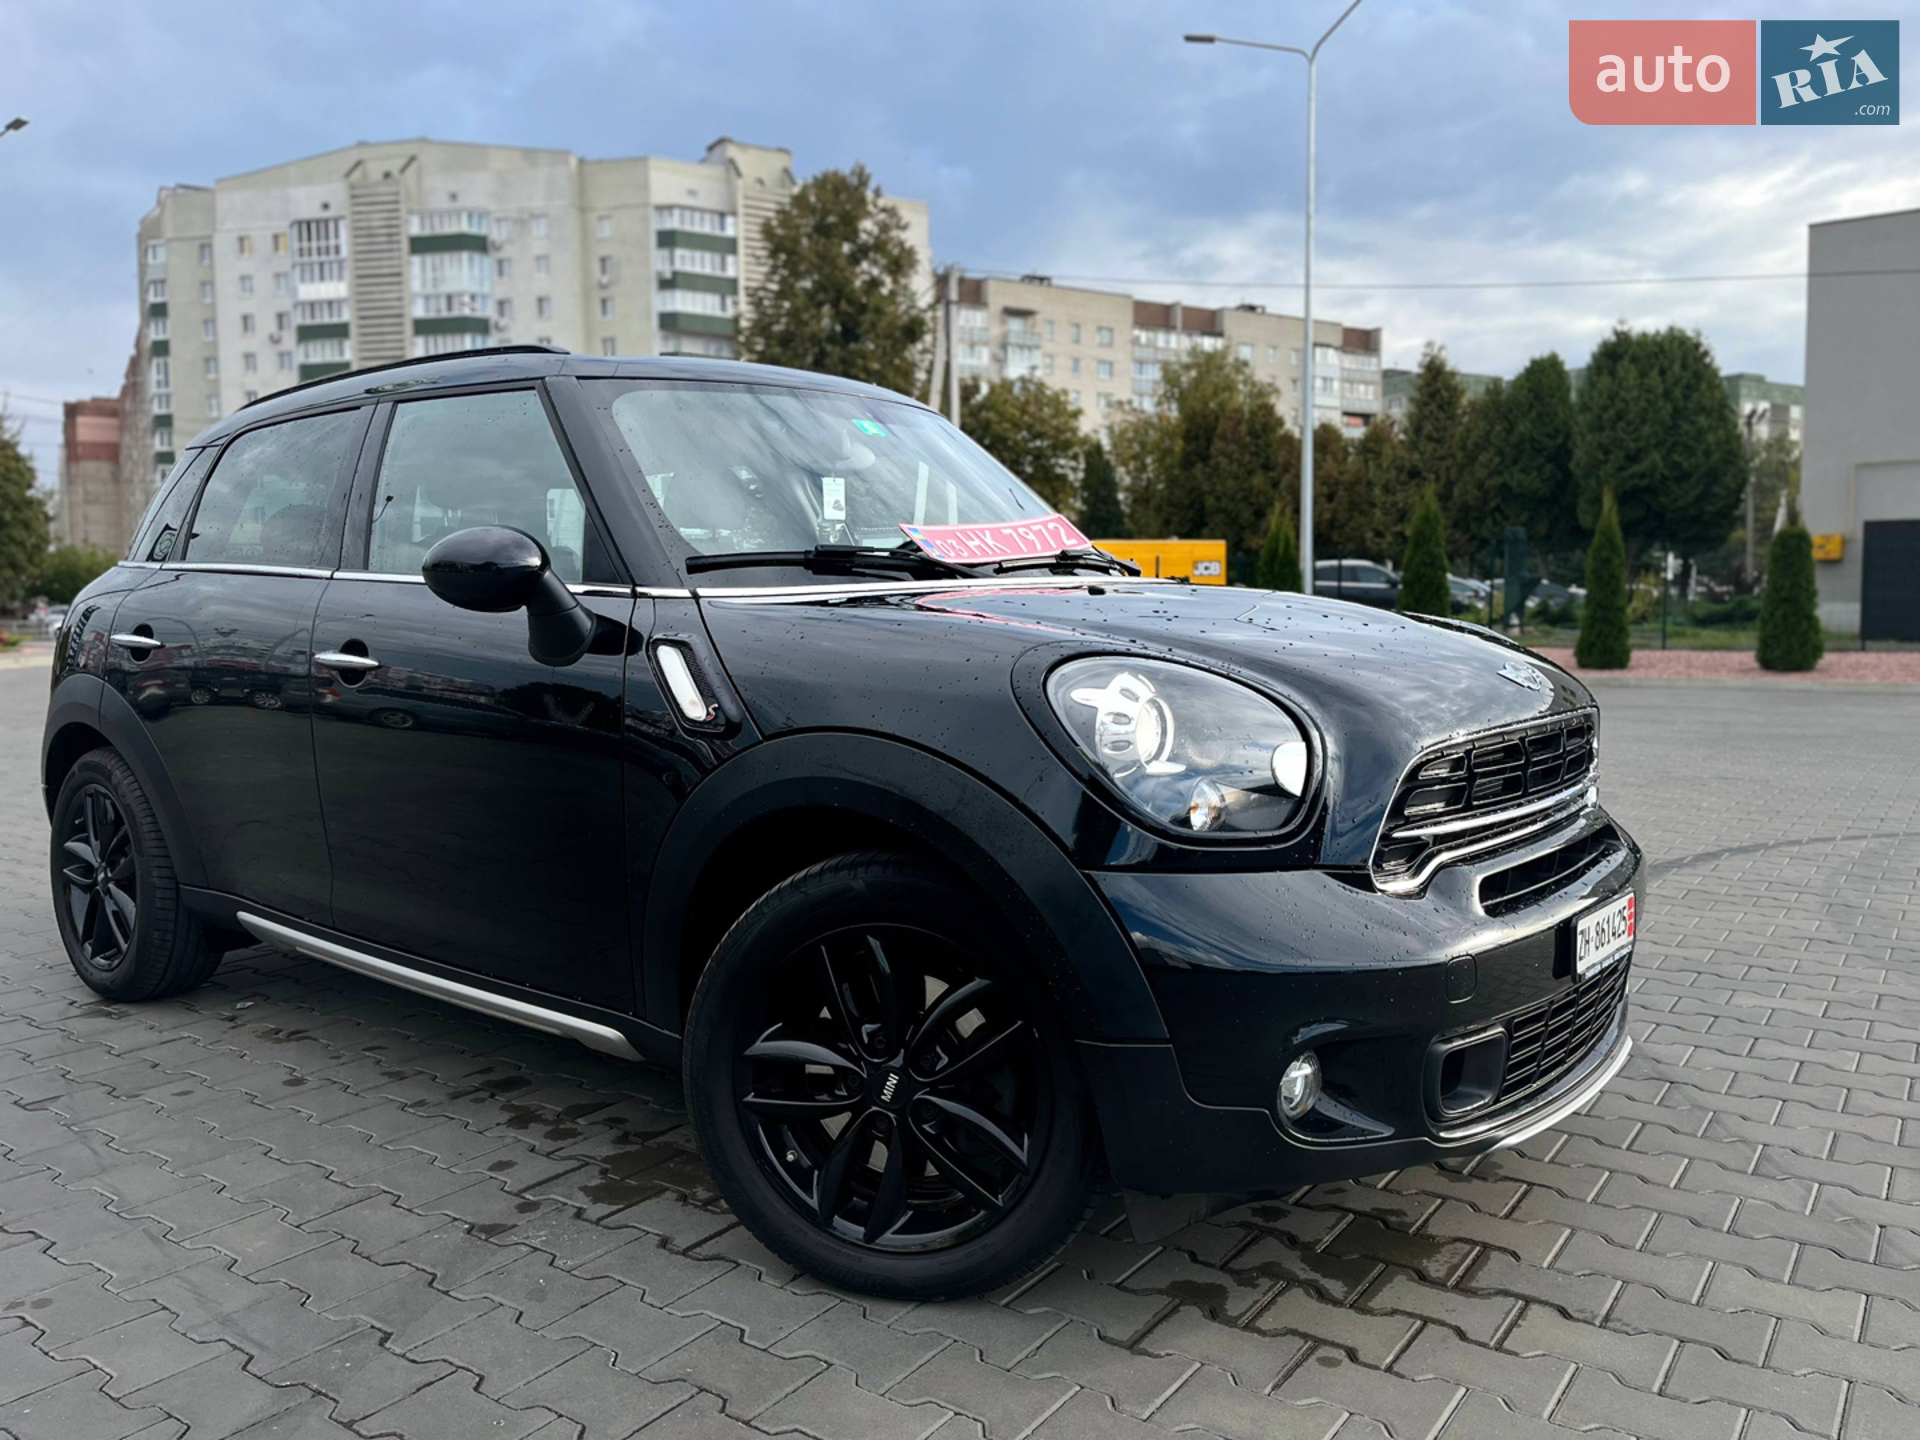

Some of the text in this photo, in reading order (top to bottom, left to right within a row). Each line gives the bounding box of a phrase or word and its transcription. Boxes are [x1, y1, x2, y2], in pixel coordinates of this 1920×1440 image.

[935, 540, 968, 558] 03
[955, 530, 1010, 556] HK
[1002, 522, 1078, 553] 7972
[881, 1072, 900, 1103] MINI
